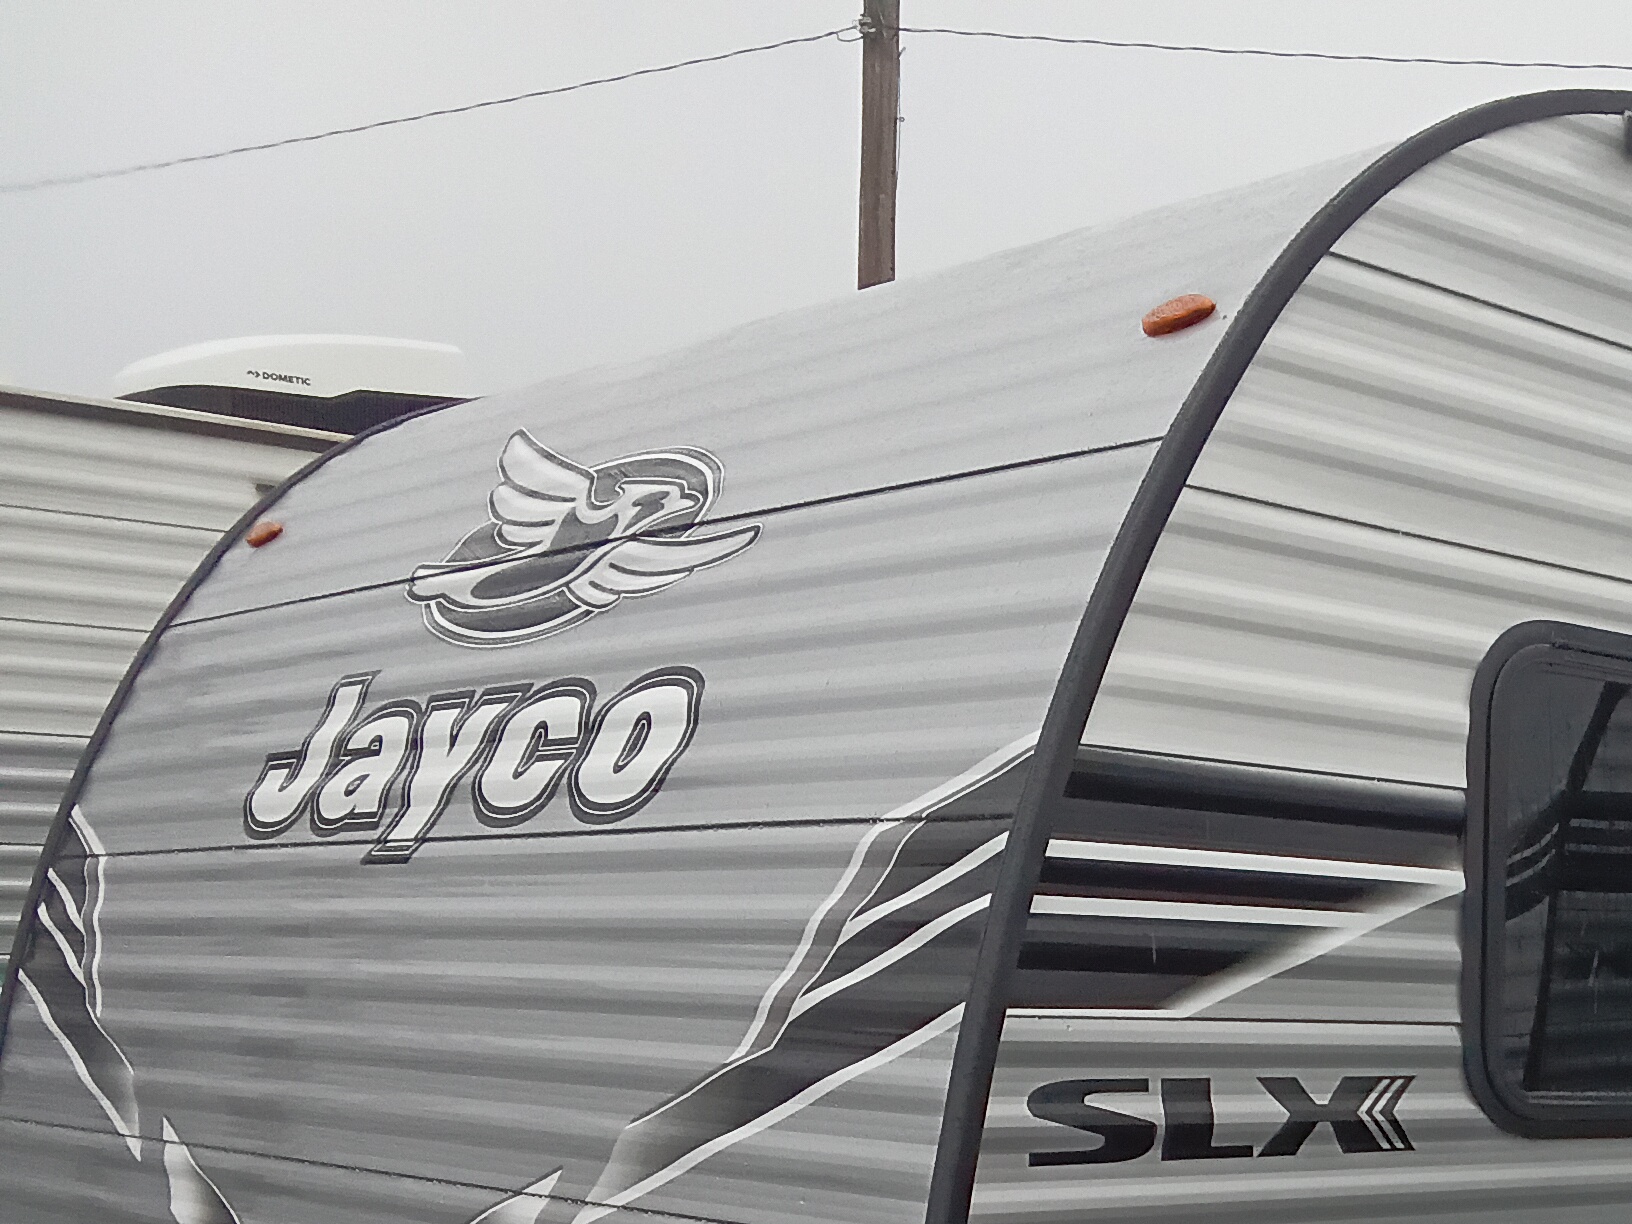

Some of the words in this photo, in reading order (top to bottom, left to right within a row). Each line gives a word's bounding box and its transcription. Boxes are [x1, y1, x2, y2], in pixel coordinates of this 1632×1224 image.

[262, 371, 311, 387] DOMETIC
[243, 665, 706, 865] Jayco
[1026, 1075, 1417, 1168] SLX
